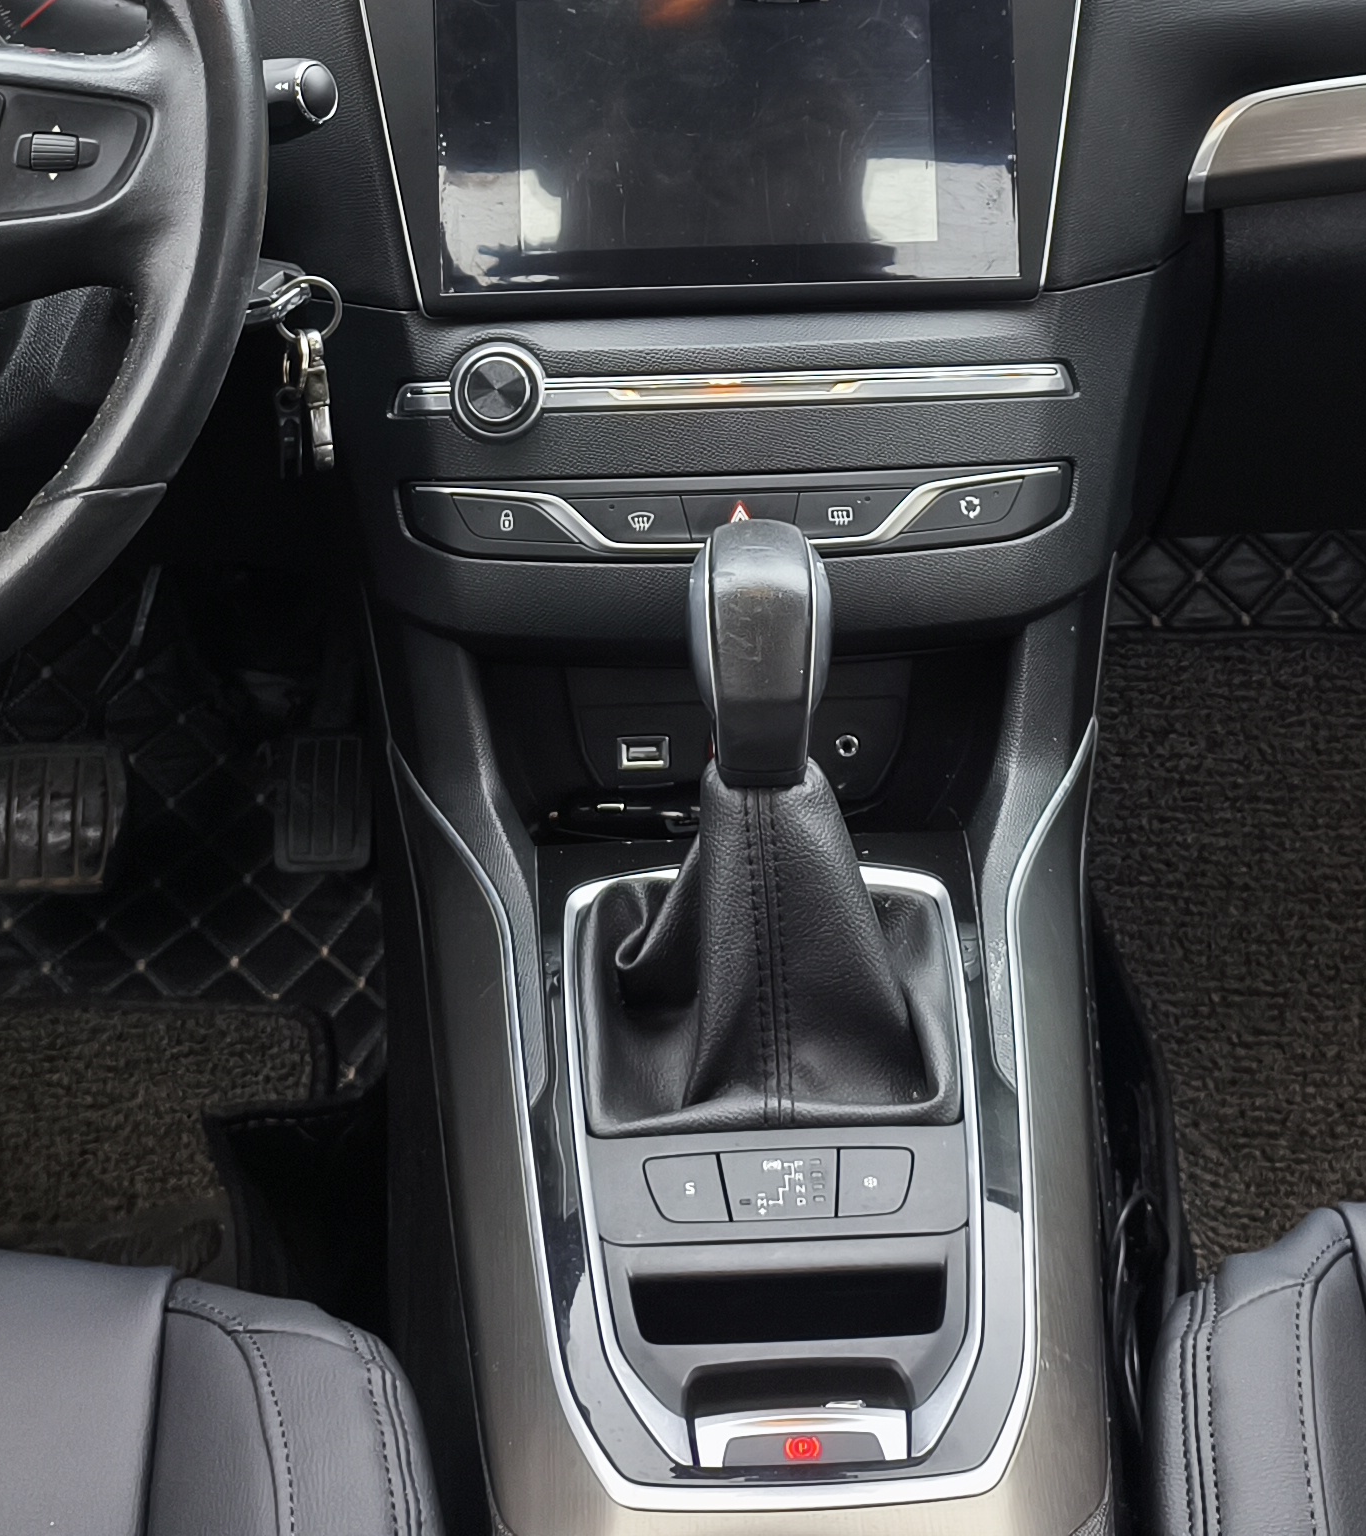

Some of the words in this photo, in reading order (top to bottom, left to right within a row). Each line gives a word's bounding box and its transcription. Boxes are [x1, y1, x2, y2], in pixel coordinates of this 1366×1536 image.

[795, 1172, 804, 1181] R
[685, 1182, 696, 1195] S
[796, 1184, 806, 1193] N
[758, 1198, 768, 1207] M
[797, 1197, 807, 1206] D
